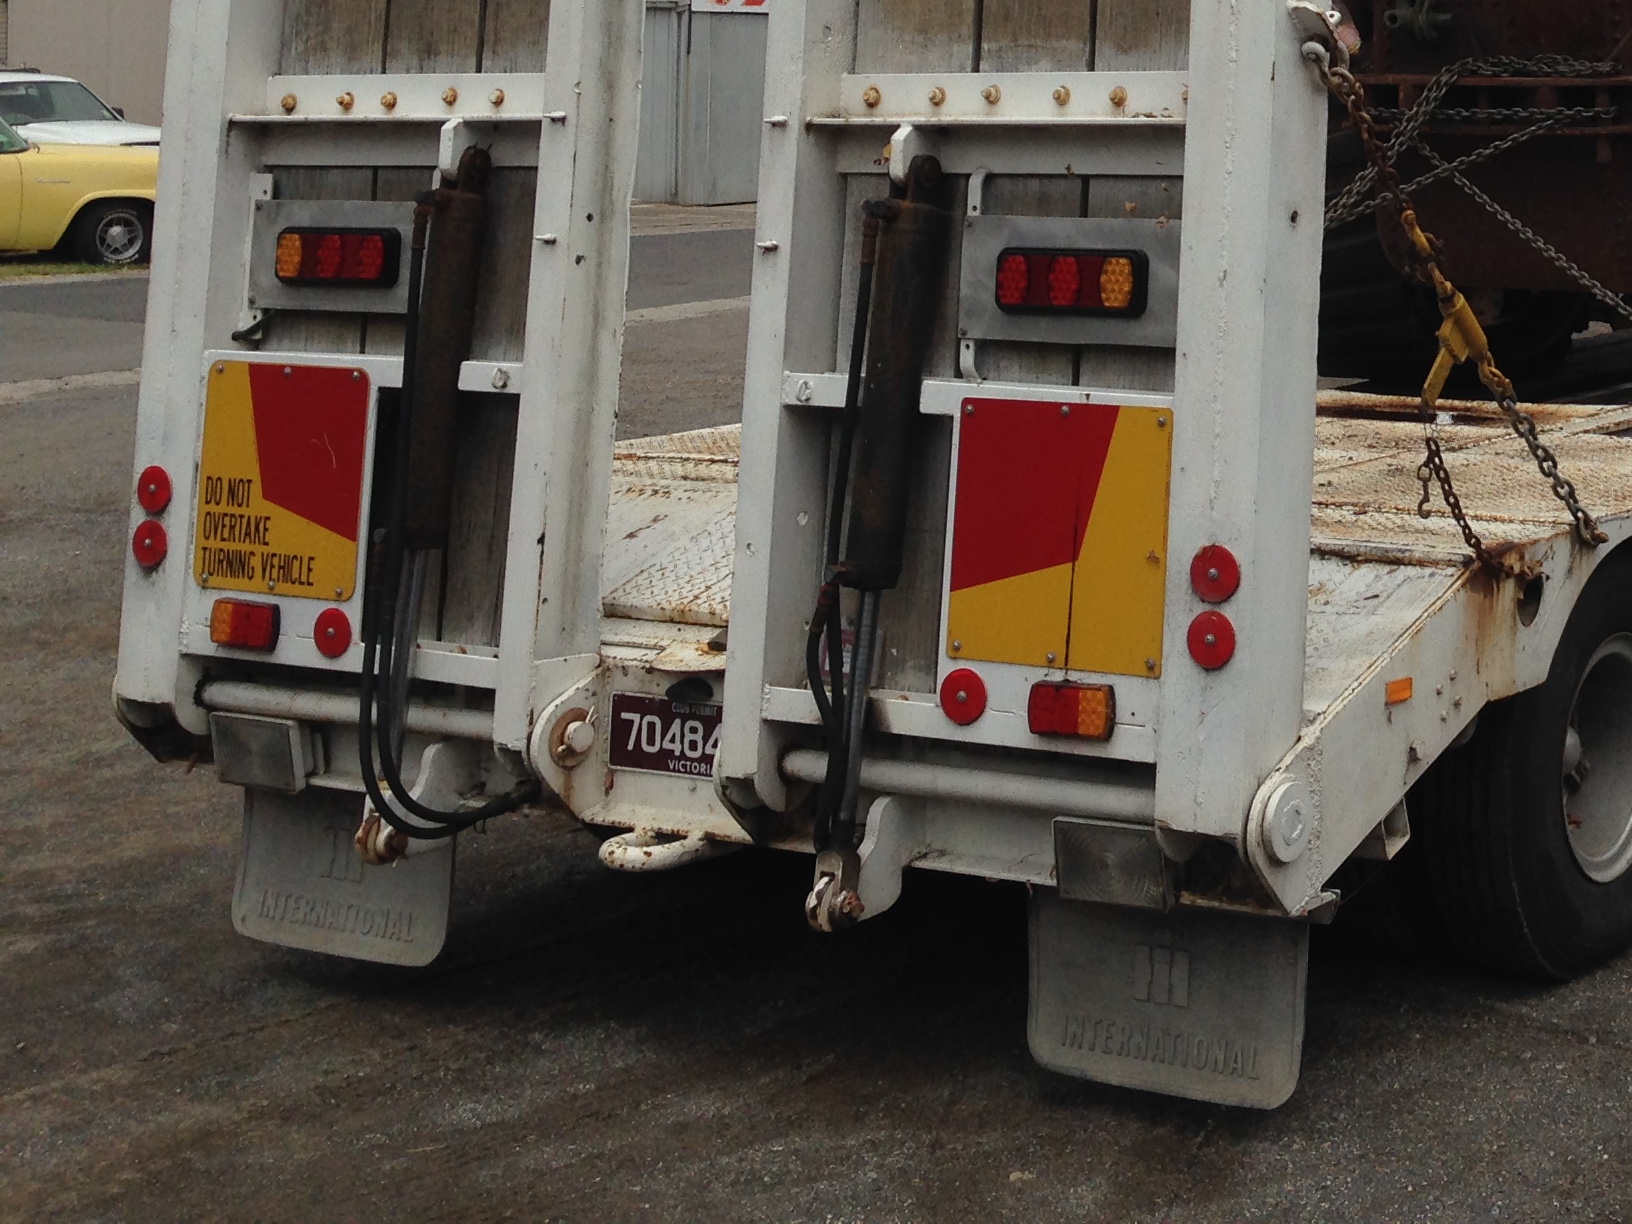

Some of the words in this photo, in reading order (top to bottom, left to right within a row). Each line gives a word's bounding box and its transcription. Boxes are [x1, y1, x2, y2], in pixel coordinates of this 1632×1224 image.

[204, 476, 223, 506] DO
[227, 478, 253, 508] NOT
[203, 511, 271, 546] OVERTAKE
[201, 546, 255, 581] TURNING
[261, 551, 316, 587] VEHICLE
[668, 759, 713, 775] VICTORI
[258, 889, 414, 943] INTERNATIONAL
[1061, 1014, 1260, 1081] INTERNATIONAL
